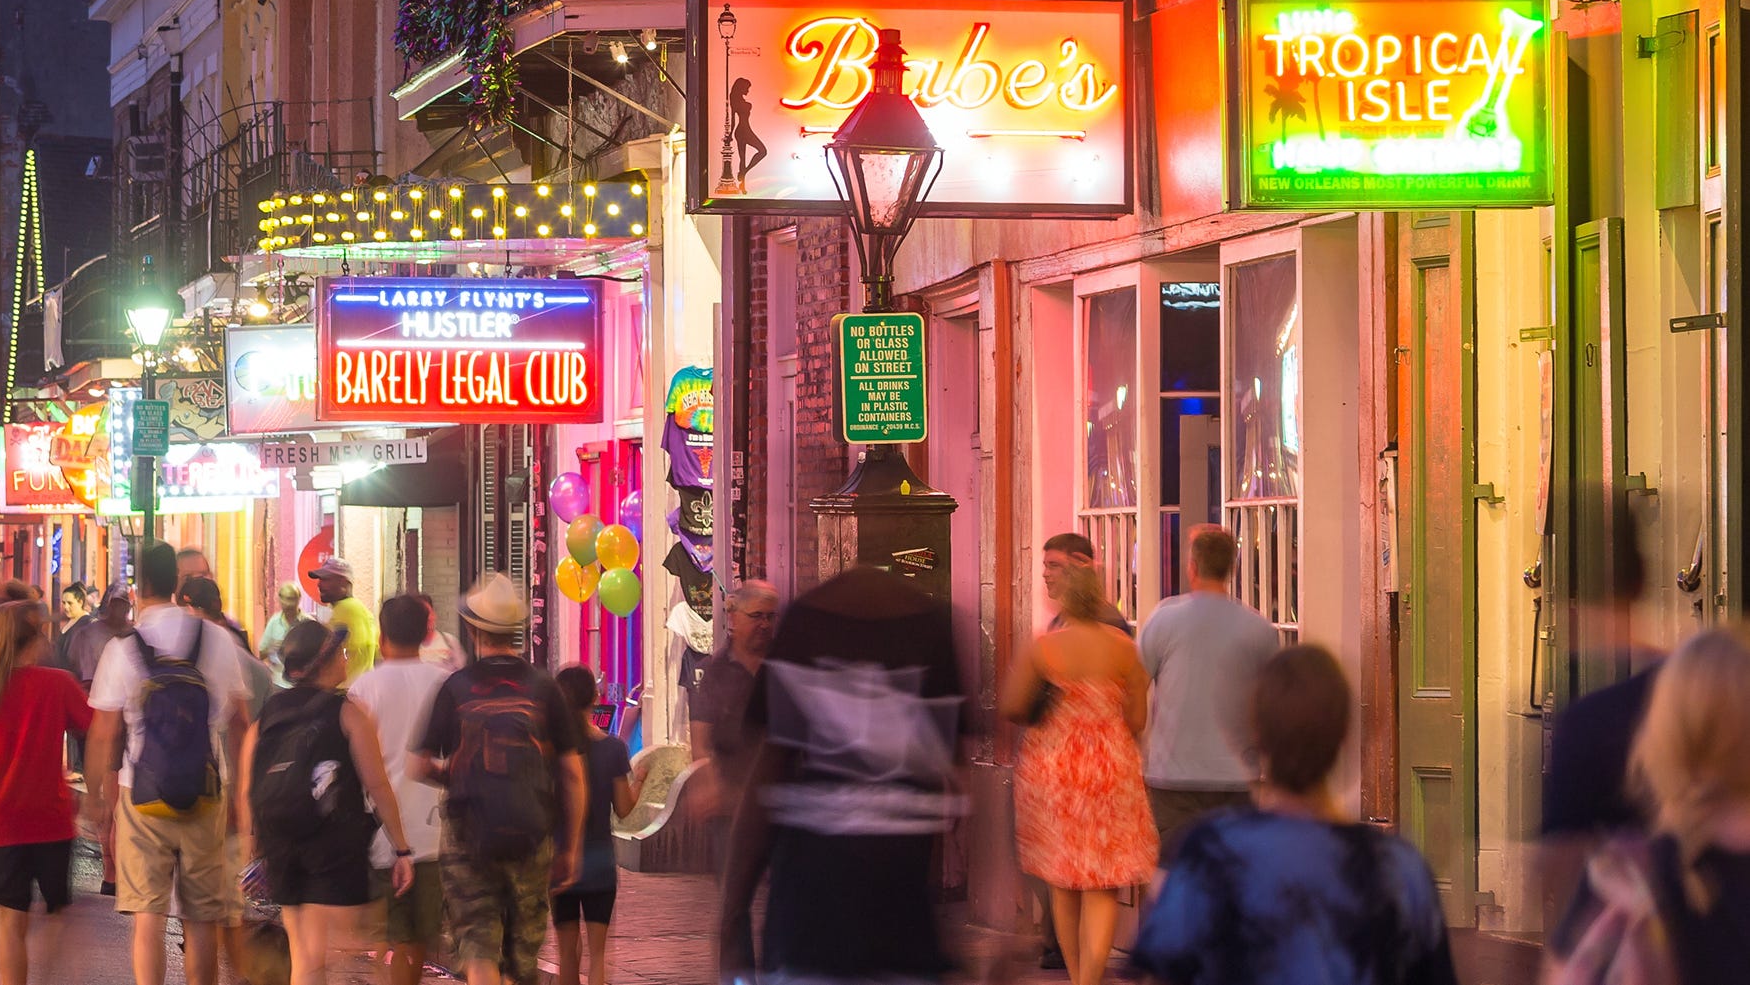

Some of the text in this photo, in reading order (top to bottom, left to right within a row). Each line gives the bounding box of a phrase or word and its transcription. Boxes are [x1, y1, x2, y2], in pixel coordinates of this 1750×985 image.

[1263, 33, 1525, 77] TROPICAL
[780, 17, 1118, 111] Babe's
[1346, 79, 1453, 122] ISLE
[1259, 175, 1532, 190] NEW ORLEANS MOST POWERFUL DRINK
[379, 290, 546, 309] LARRY FLYNT'S
[850, 325, 915, 337] NO BOTTLES
[856, 337, 909, 349] OR GLASS
[859, 350, 908, 361] ALLOWED
[854, 362, 912, 373] ON STREET
[336, 349, 433, 405] BARELY
[440, 349, 519, 406] LEGAL
[525, 349, 588, 405] CLUB
[859, 381, 910, 391] ALL DRINKS
[868, 392, 901, 401] MAY BE
[861, 402, 909, 412] IN PLASTIC
[858, 412, 912, 422] CONTAINERS
[264, 446, 320, 464] FRESH
[373, 442, 424, 460] GRILL
[13, 470, 71, 492] FUN
